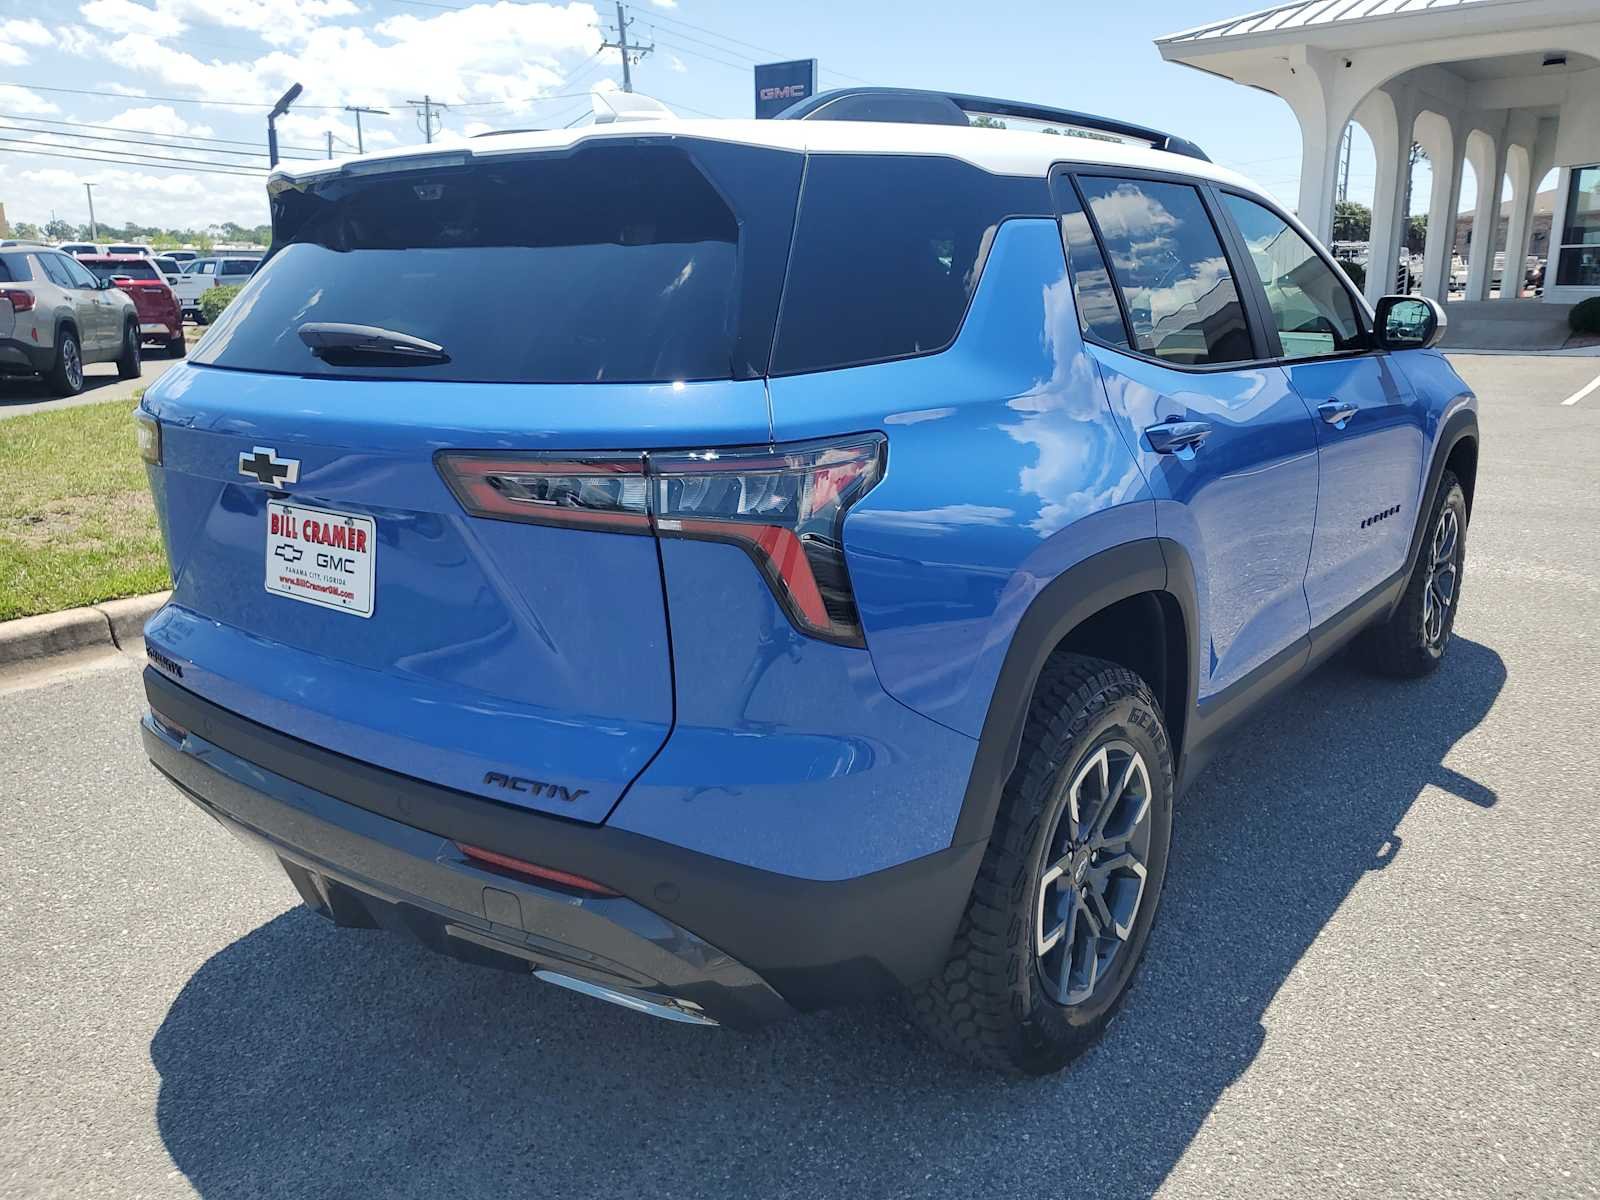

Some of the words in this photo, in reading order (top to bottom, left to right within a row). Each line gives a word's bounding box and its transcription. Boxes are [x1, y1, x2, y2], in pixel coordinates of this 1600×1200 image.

[760, 85, 804, 100] GMC
[271, 513, 298, 539] BILL
[303, 520, 367, 553] CRAMER
[317, 553, 355, 574] GMC
[286, 566, 308, 577] PANAMA
[323, 575, 346, 585] FLORIDA
[483, 771, 590, 802] ACTIV
